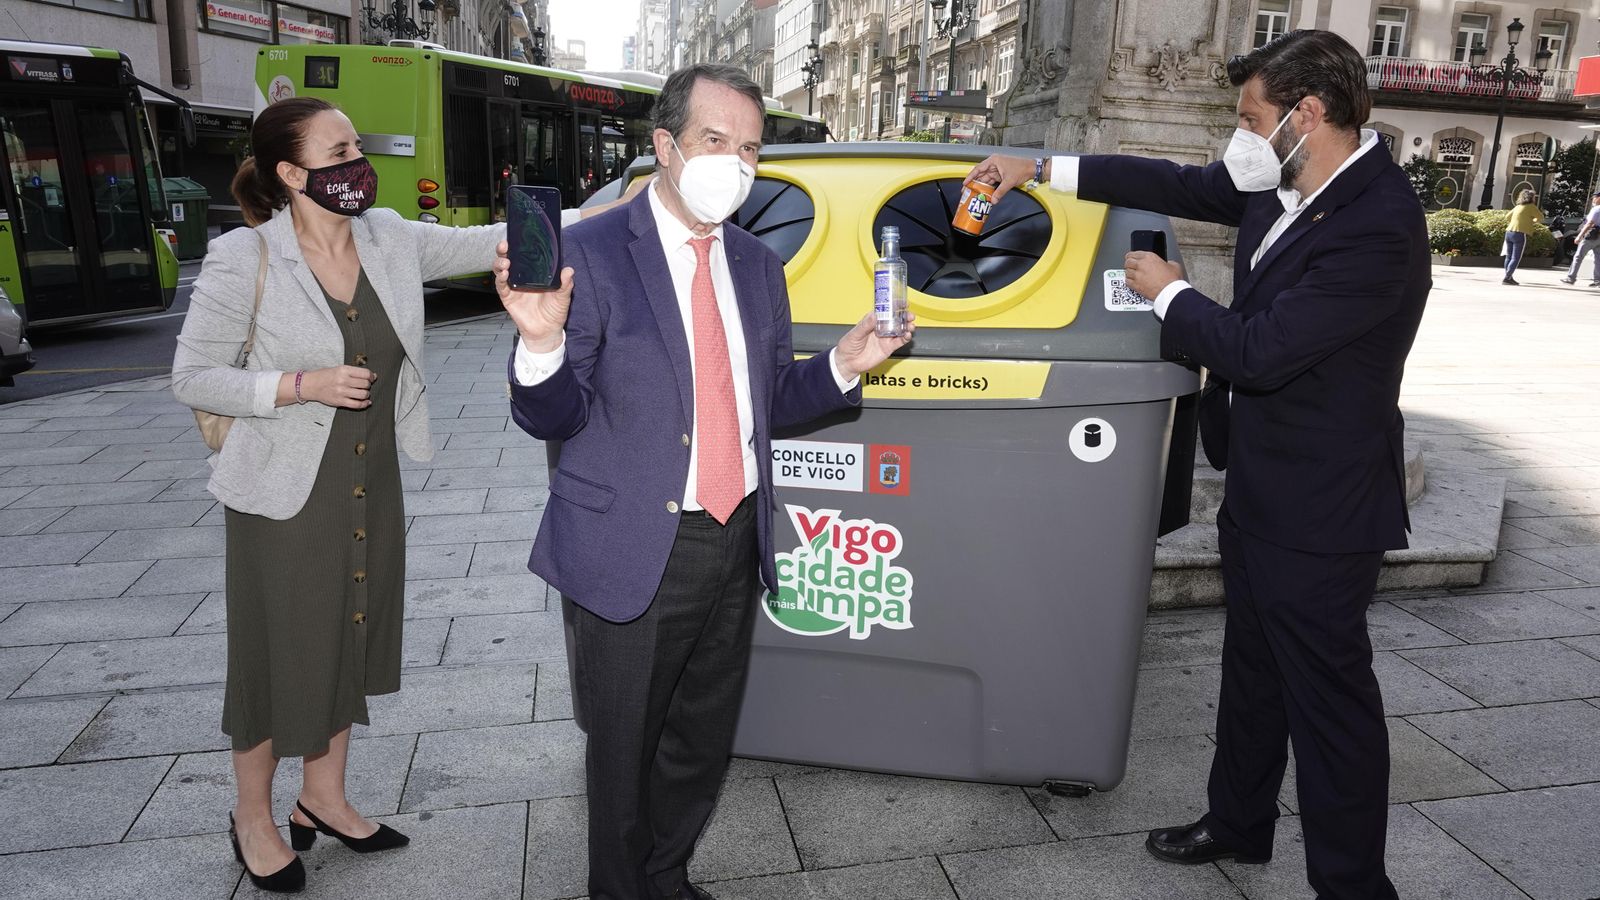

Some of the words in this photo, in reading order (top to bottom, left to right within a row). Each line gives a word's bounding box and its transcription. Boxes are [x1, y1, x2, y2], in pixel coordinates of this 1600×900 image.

[218, 8, 247, 21] General
[288, 23, 313, 34] General
[269, 50, 288, 61] 6701
[372, 55, 404, 65] avanza
[27, 70, 58, 78] VITRASA
[504, 75, 520, 87] 6701
[570, 84, 615, 104] avanza
[865, 372, 906, 387] latas
[911, 377, 922, 388] e
[928, 375, 988, 391] bricks)
[772, 449, 856, 466] CONCELLO
[782, 465, 802, 478] DE
[807, 466, 846, 481] VIGO
[795, 512, 896, 565] Vigo
